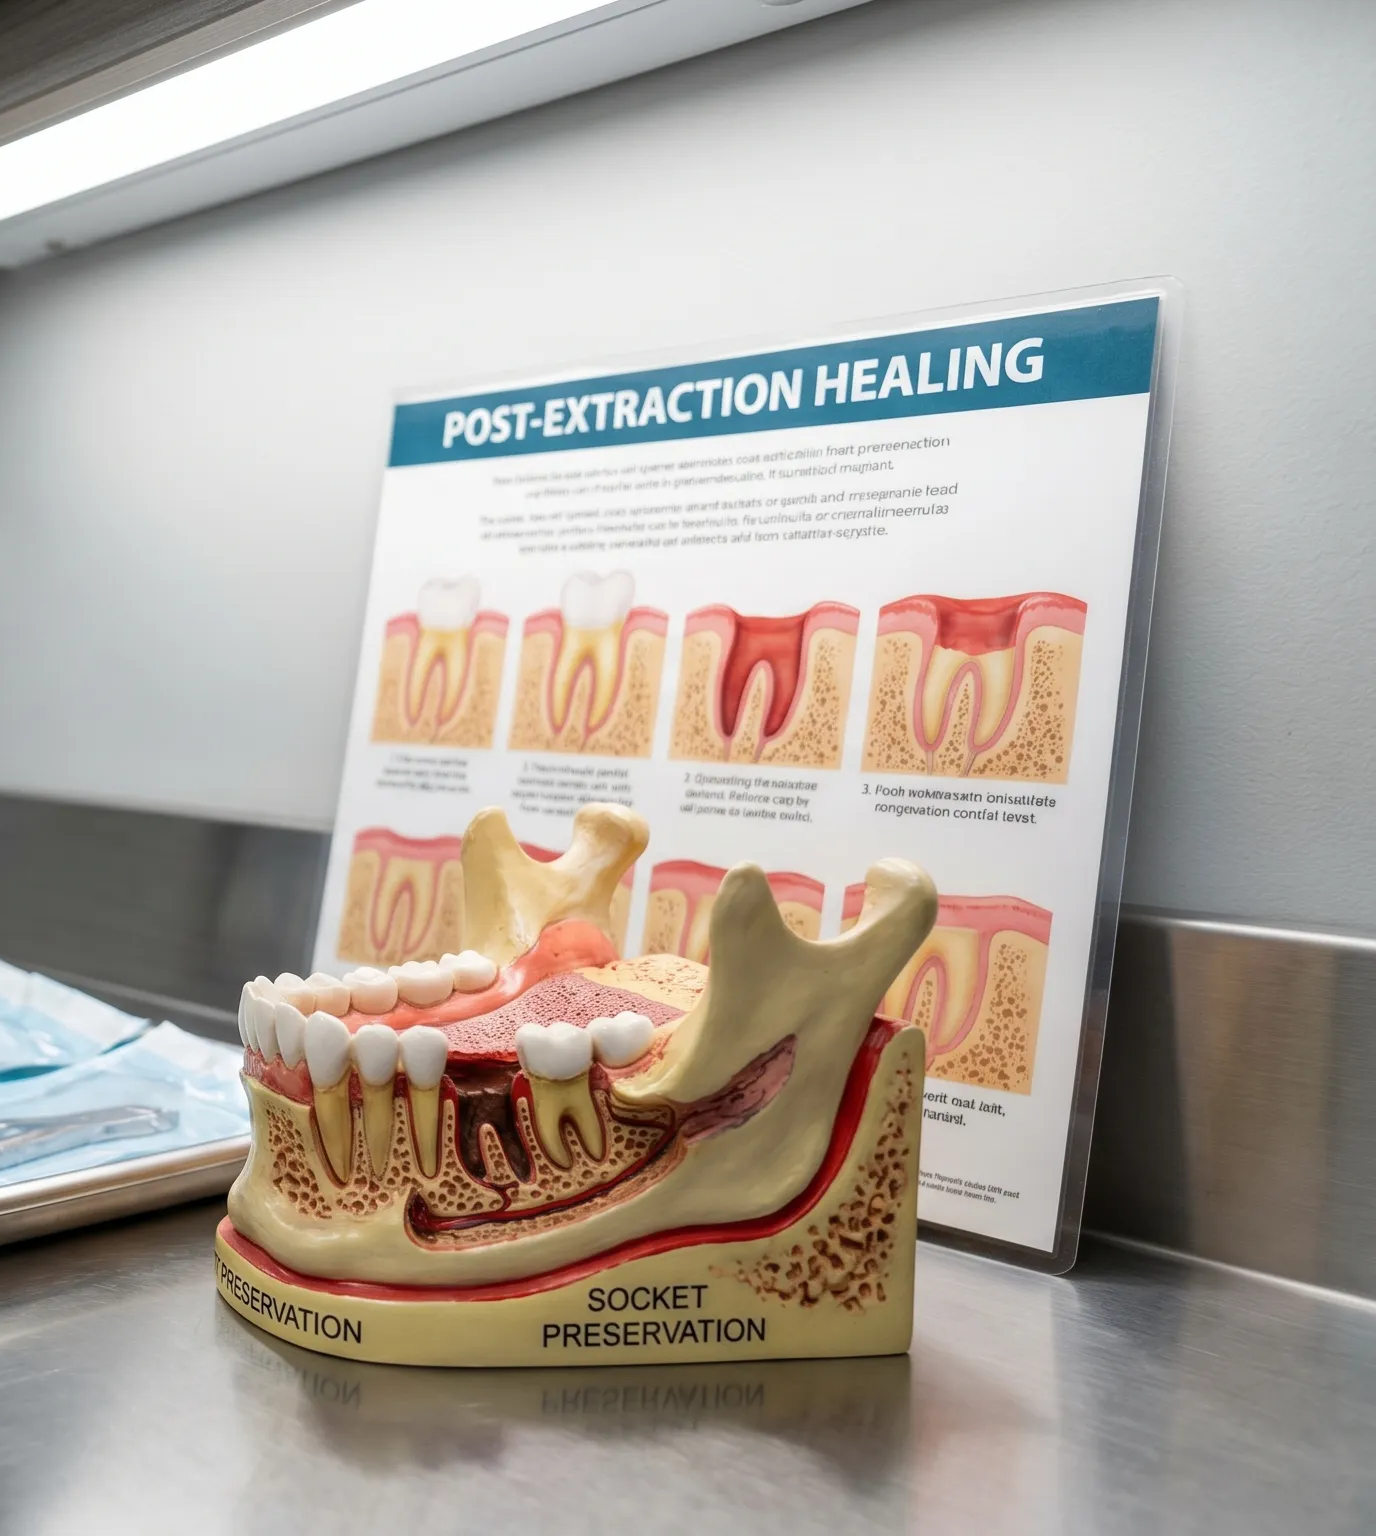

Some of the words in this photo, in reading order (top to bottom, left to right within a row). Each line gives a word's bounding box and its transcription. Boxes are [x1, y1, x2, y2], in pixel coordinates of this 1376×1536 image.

[442, 368, 803, 448] POST-EXTRACTION
[814, 337, 1044, 406] HEALING
[861, 784, 872, 795] 3.
[221, 1263, 362, 1344] PRESERVATION
[587, 1284, 708, 1312] SOCKET
[542, 1318, 766, 1348] PRESERVATION
